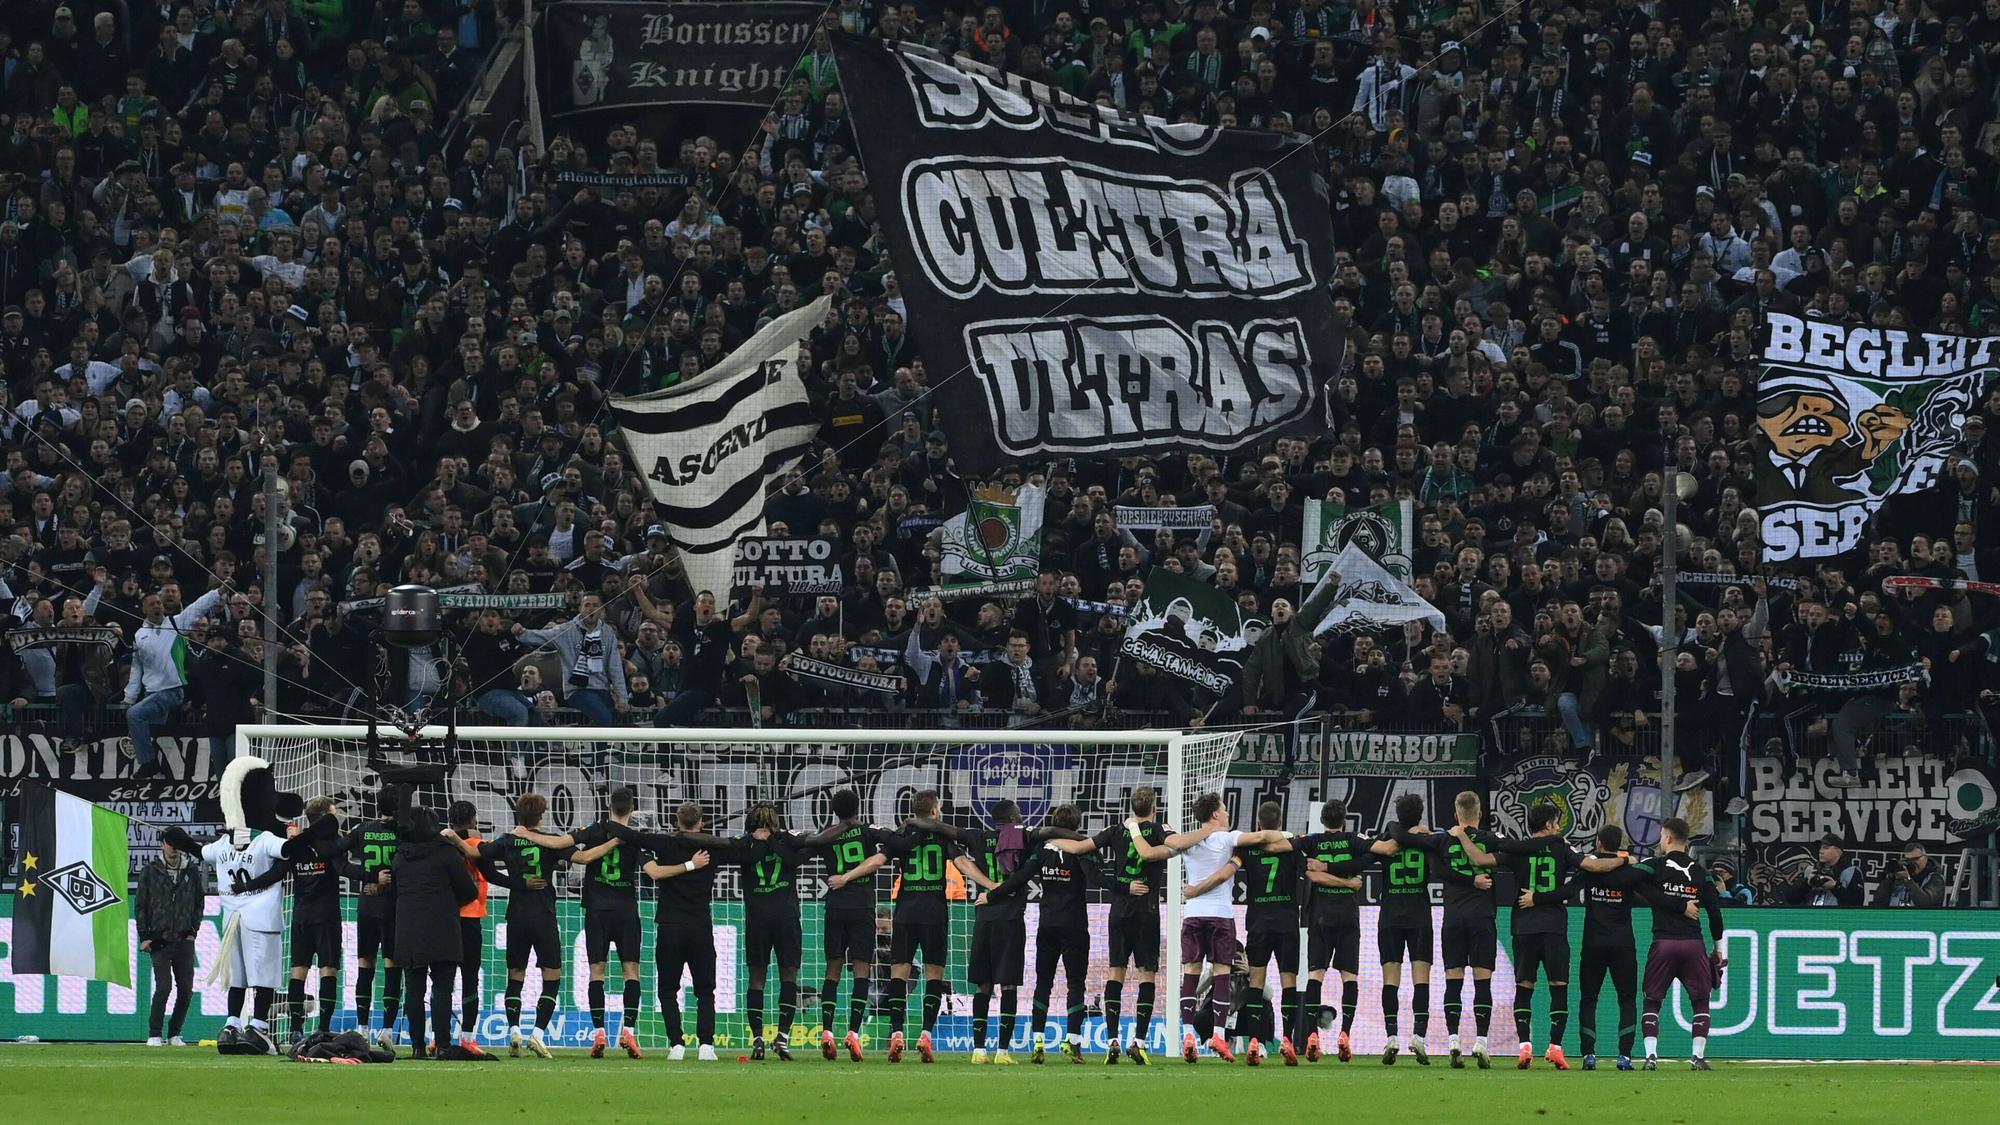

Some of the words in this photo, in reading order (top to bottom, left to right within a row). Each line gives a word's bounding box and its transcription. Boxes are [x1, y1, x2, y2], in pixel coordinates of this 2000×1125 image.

[639, 13, 811, 49] Borussen
[906, 160, 1312, 297] CULTURA
[969, 319, 1311, 450] ULTRAS
[734, 539, 831, 561] SOTTO
[731, 563, 843, 588] ULTURA
[447, 593, 566, 608] STADIONVERBOT
[792, 656, 898, 691] SOTTOCULTURA
[1789, 668, 1908, 688] BEGLEITSERVICE
[1230, 733, 1457, 764] STAIONVERBOT
[1521, 757, 1556, 771] NORD
[109, 783, 153, 801] seit
[1751, 799, 1947, 843] SERVICE
[295, 861, 326, 871] flatex
[520, 846, 543, 881] 3
[832, 840, 866, 874] 19
[904, 843, 944, 882] 30
[1041, 866, 1073, 877] flatex
[1388, 848, 1426, 886] 29
[1260, 856, 1281, 894] 7
[1528, 855, 1557, 894] 13
[1662, 881, 1698, 895] flatex
[1590, 886, 1623, 897] flatex
